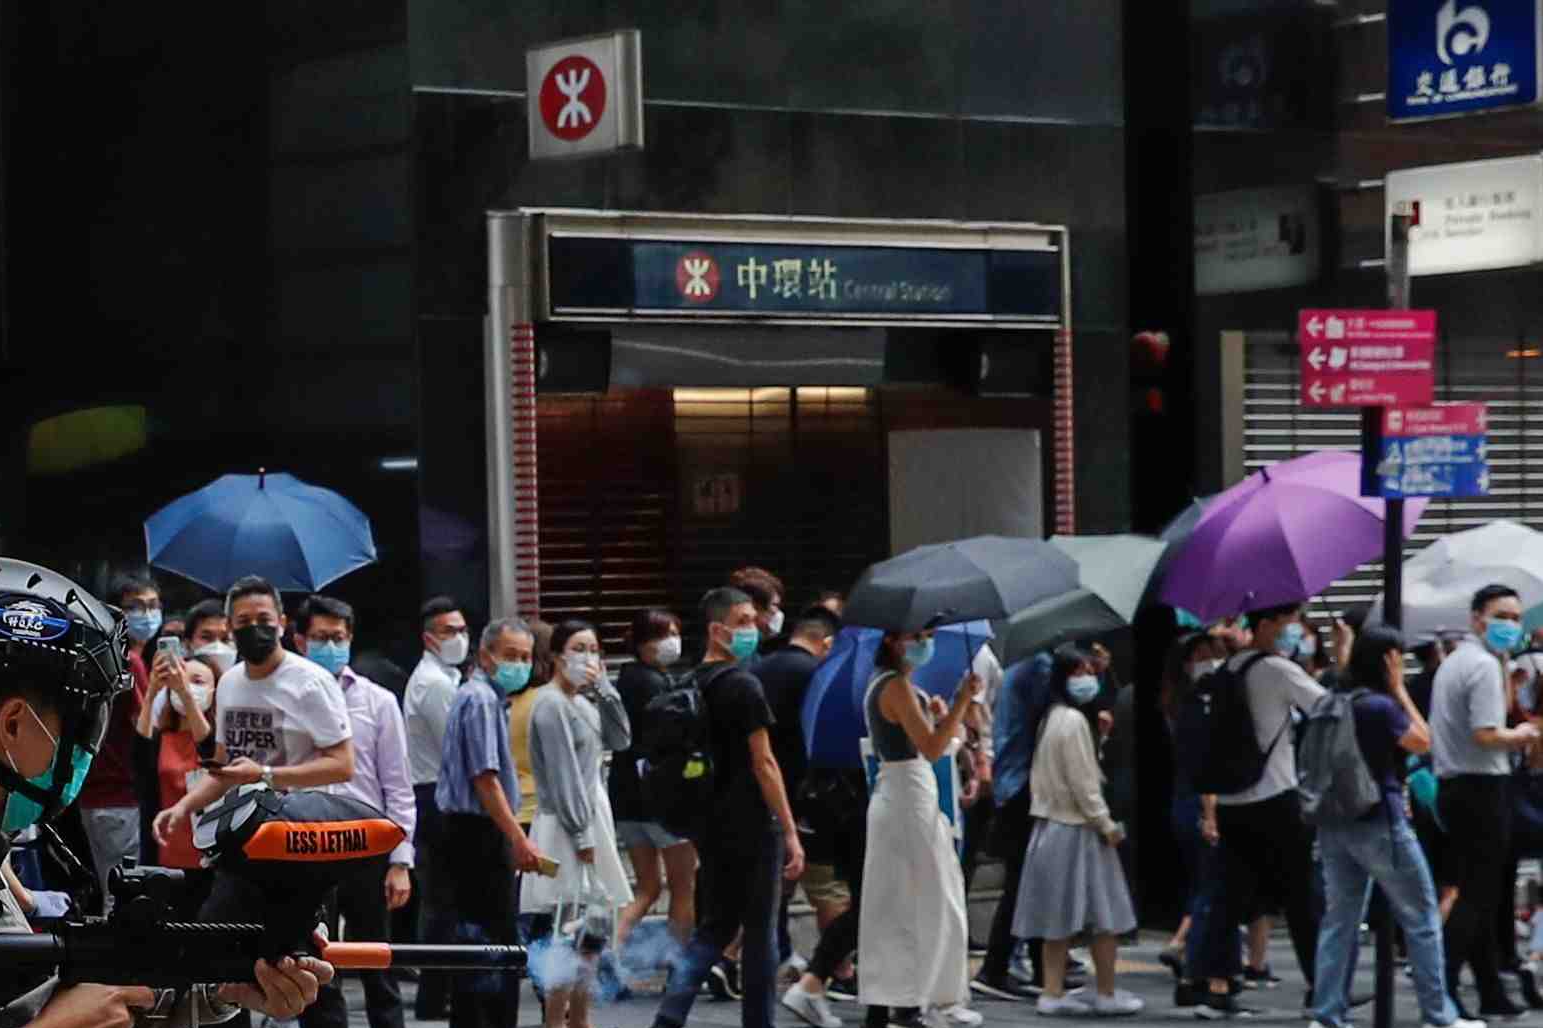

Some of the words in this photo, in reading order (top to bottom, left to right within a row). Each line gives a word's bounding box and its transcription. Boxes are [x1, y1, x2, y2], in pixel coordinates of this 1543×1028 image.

[737, 257, 837, 299] 中環站
[225, 730, 277, 750] SUPER
[286, 830, 318, 854] LESS
[321, 828, 367, 852] LETHAL
